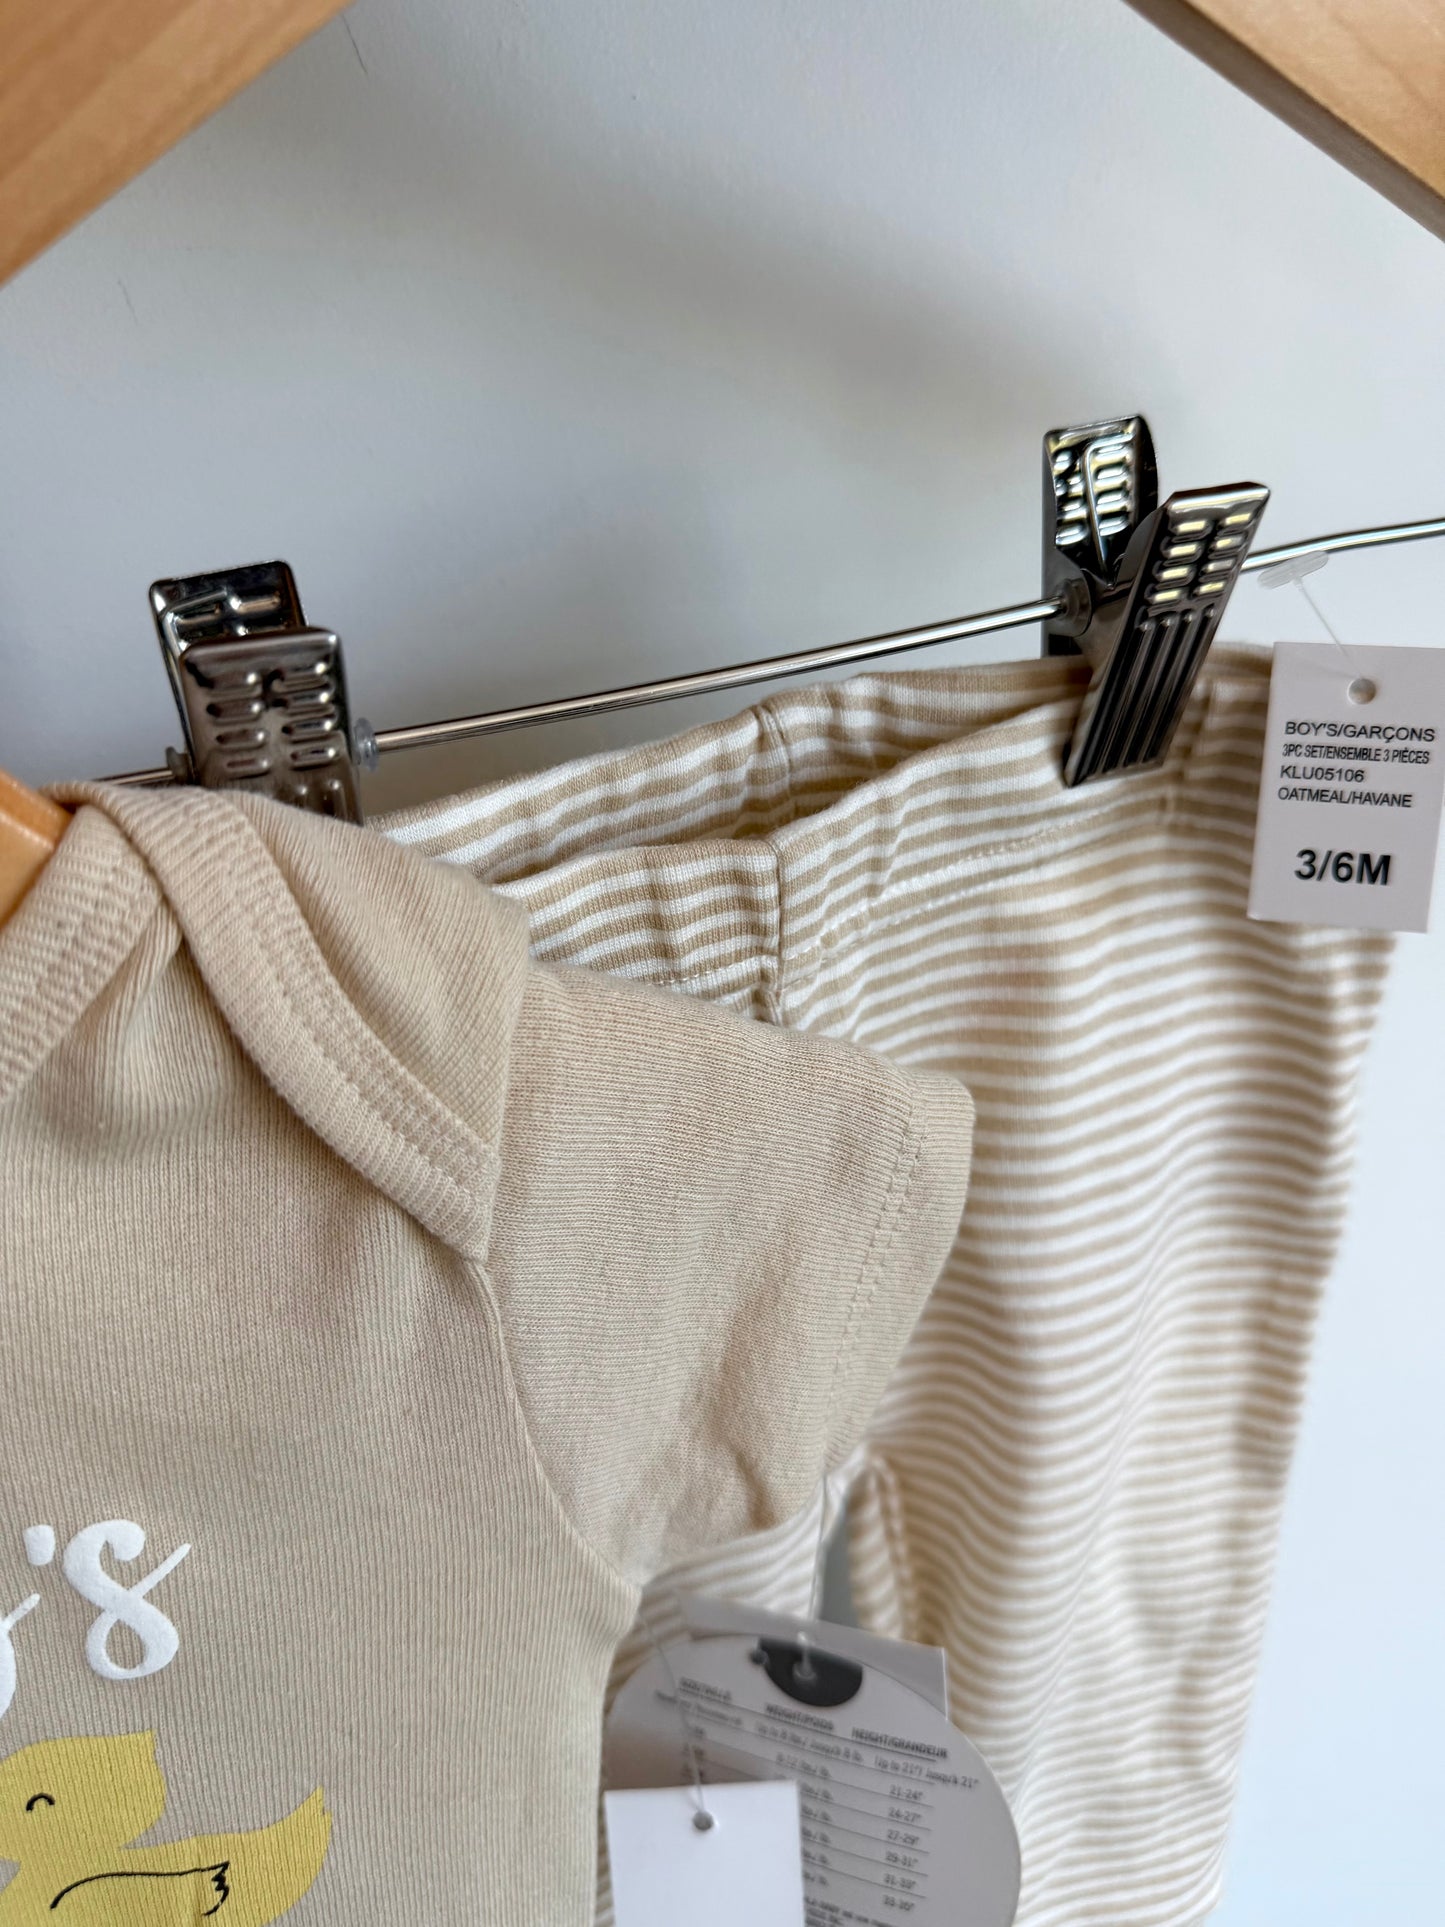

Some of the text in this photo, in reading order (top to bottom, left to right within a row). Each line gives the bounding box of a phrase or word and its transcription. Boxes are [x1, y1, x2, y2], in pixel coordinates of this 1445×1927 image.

[1284, 721, 1435, 743] BOY'S/GARÇONS
[1282, 743, 1303, 757] 3PC
[1303, 744, 1381, 762] SET/ENSEMBLE
[1382, 750, 1390, 762] 3
[1280, 765, 1365, 783] KLU05106
[1278, 787, 1413, 808] OATMEAL/HAVANE
[1294, 849, 1391, 886] 3/6M
